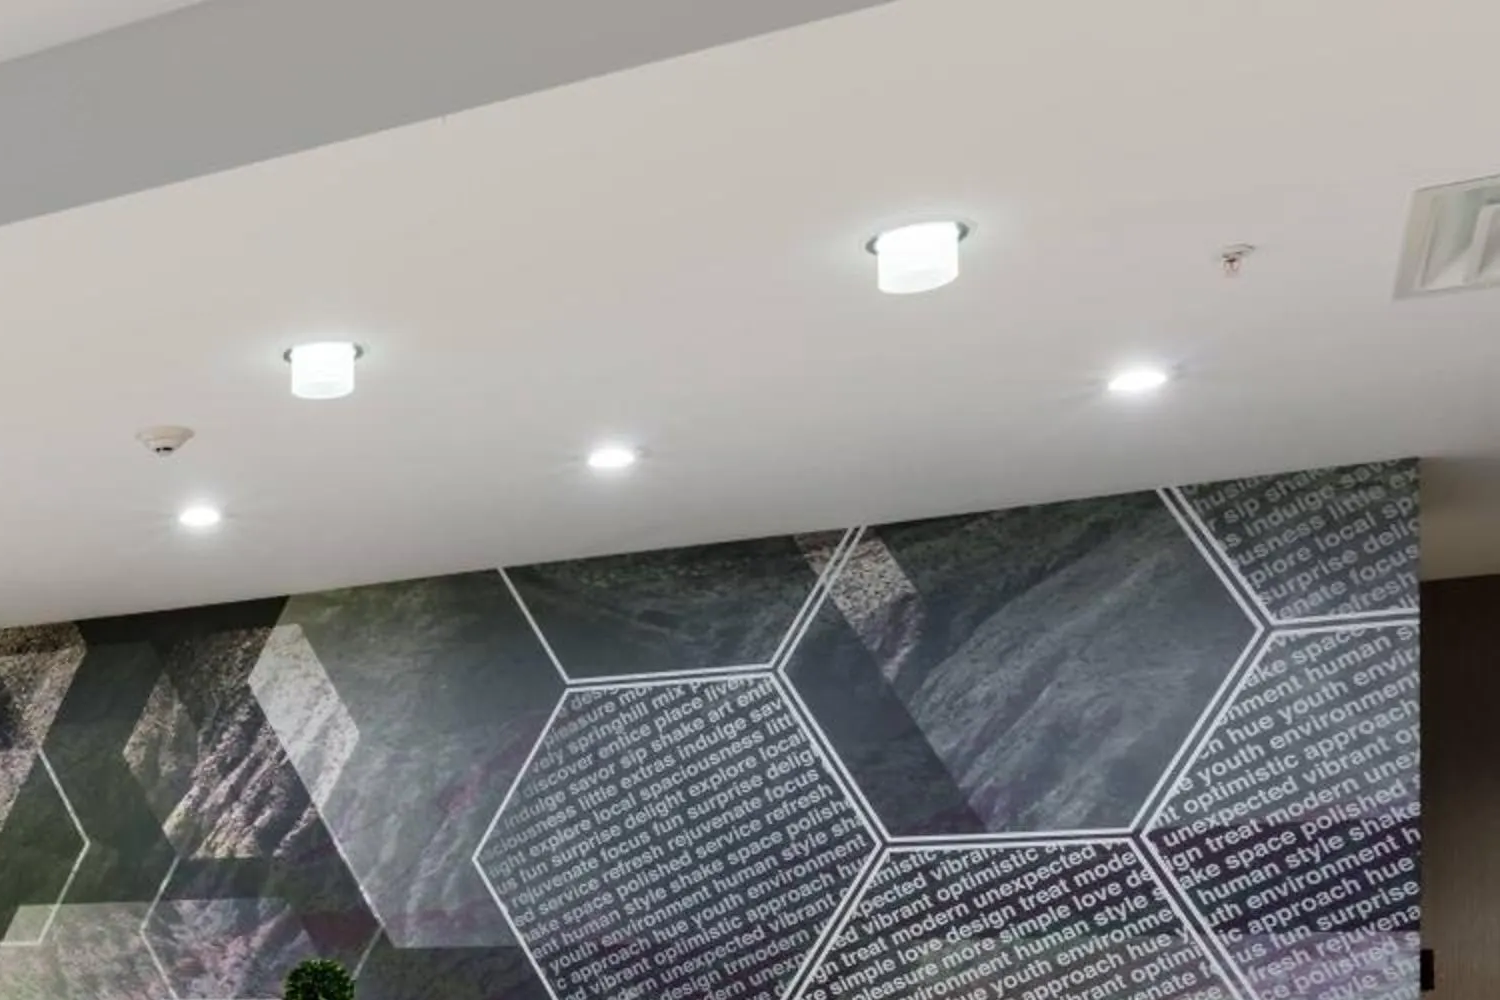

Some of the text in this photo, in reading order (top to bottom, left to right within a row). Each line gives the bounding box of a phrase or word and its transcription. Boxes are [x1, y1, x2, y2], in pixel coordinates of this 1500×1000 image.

[565, 698, 649, 755] springhill
[649, 681, 686, 709] mix
[1223, 711, 1276, 744] hue
[1275, 673, 1349, 725] youth
[1301, 632, 1392, 683] human
[567, 761, 618, 796] savor
[617, 745, 651, 770] sip
[649, 714, 706, 753] shake
[705, 697, 735, 723] art
[576, 781, 619, 811] little
[617, 752, 677, 790] extras
[675, 715, 748, 760] indulge
[595, 721, 653, 760] entice
[652, 694, 705, 733] place
[1180, 751, 1301, 814] optimistic
[1195, 737, 1266, 787] youth
[510, 854, 600, 908] rejuvenate
[598, 828, 651, 863] focus
[650, 811, 684, 837] fun
[684, 771, 765, 820] surprise
[517, 859, 549, 883] fun
[549, 821, 623, 867] surprise
[620, 787, 687, 830] delight
[685, 753, 759, 798] explore
[526, 816, 593, 858] explore
[591, 789, 638, 824] local
[637, 728, 766, 802] spaciousness
[536, 875, 601, 916] service
[600, 839, 665, 884] refresh
[665, 794, 764, 851] rejuvenate
[763, 766, 820, 802] focus
[560, 889, 615, 924] space
[614, 847, 693, 901] polished
[693, 816, 764, 860] service
[763, 778, 834, 825] refresh
[547, 936, 599, 976] youth
[598, 882, 712, 949] environment
[710, 853, 780, 893] human
[779, 829, 829, 862] style
[558, 907, 622, 946] human
[621, 884, 668, 916] style
[667, 857, 726, 894] shake
[725, 828, 785, 866] space
[567, 932, 651, 985] approach
[650, 917, 689, 944] hue
[689, 887, 745, 930] youth
[744, 830, 867, 900] environment
[827, 955, 897, 996] simple
[895, 935, 944, 965] love
[941, 902, 1017, 945] design
[1016, 875, 1071, 911] treat
[1160, 772, 1299, 848] unexpected
[1300, 732, 1393, 786] vibrant
[838, 933, 889, 967] treat
[889, 900, 970, 945] modern
[972, 838, 1098, 909] unexpected
[860, 890, 935, 936] vibrant
[934, 845, 1040, 903] optimistic
[940, 934, 998, 969] more
[996, 902, 1072, 945] simple
[1070, 879, 1124, 911] love
[1203, 814, 1264, 853] treat
[1264, 774, 1361, 827] modern
[988, 954, 1053, 999] youth
[1195, 860, 1282, 905] human
[1282, 832, 1347, 870] style
[1346, 798, 1425, 842] shake
[1011, 917, 1090, 960] human
[1090, 891, 1149, 926] style
[1222, 828, 1298, 871] space
[1298, 776, 1408, 842] polished
[1123, 929, 1173, 960] hue
[1243, 831, 1401, 911] environment
[1245, 871, 1362, 935] approach
[1361, 854, 1416, 886] hue
[1266, 921, 1313, 950] fun
[1313, 877, 1422, 932] surprise
[587, 954, 652, 996] vibrant
[652, 913, 744, 965] optimistic
[744, 866, 836, 923] approach
[658, 921, 765, 984] unexpected
[766, 890, 837, 934] vibrant
